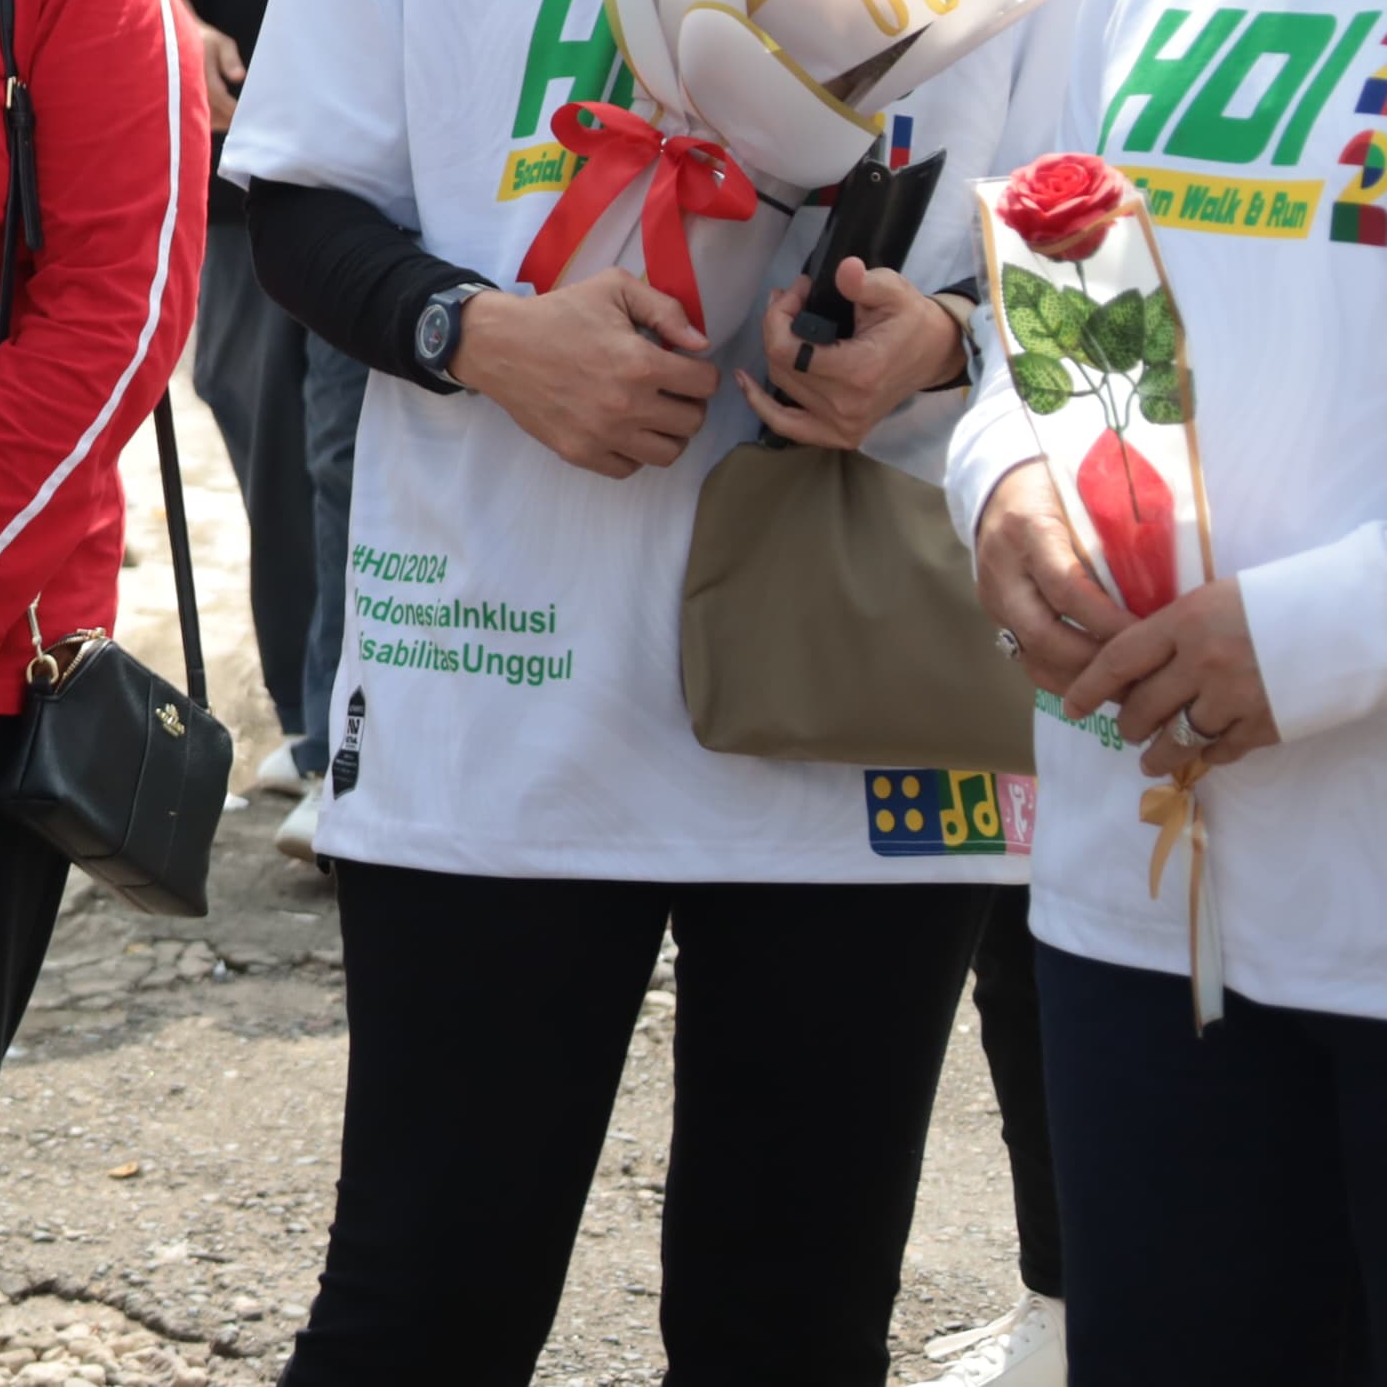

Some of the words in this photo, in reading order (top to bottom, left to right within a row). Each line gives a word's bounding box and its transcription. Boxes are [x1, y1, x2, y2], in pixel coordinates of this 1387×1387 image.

[1095, 7, 1382, 166] HDI
[511, 149, 567, 191] Social
[1179, 183, 1244, 226] Walk
[1243, 189, 1266, 227] &
[1266, 190, 1309, 229] Run
[352, 543, 448, 584] #HDI2024
[353, 587, 556, 634] IndonesiaInklusi
[358, 631, 573, 687] isabilitasUnggul
